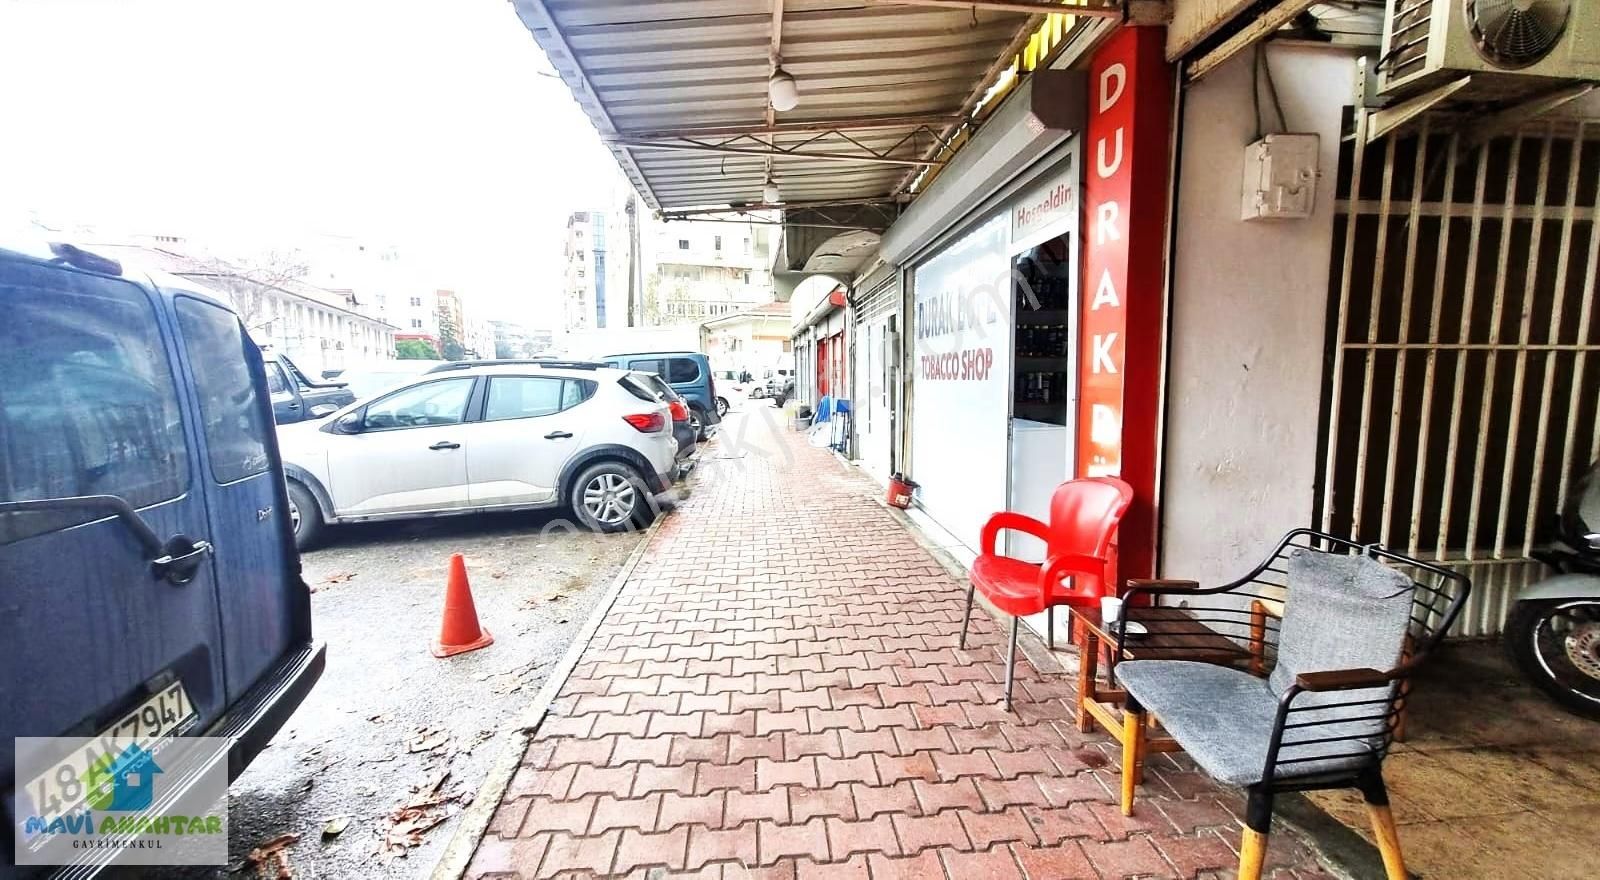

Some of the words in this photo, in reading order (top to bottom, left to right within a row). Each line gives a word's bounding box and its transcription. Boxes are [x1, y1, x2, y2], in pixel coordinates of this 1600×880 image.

[1090, 62, 1127, 374] DURAK
[918, 291, 955, 340] DURAK
[921, 351, 960, 380] TOBACCO
[961, 347, 993, 381] SHOP
